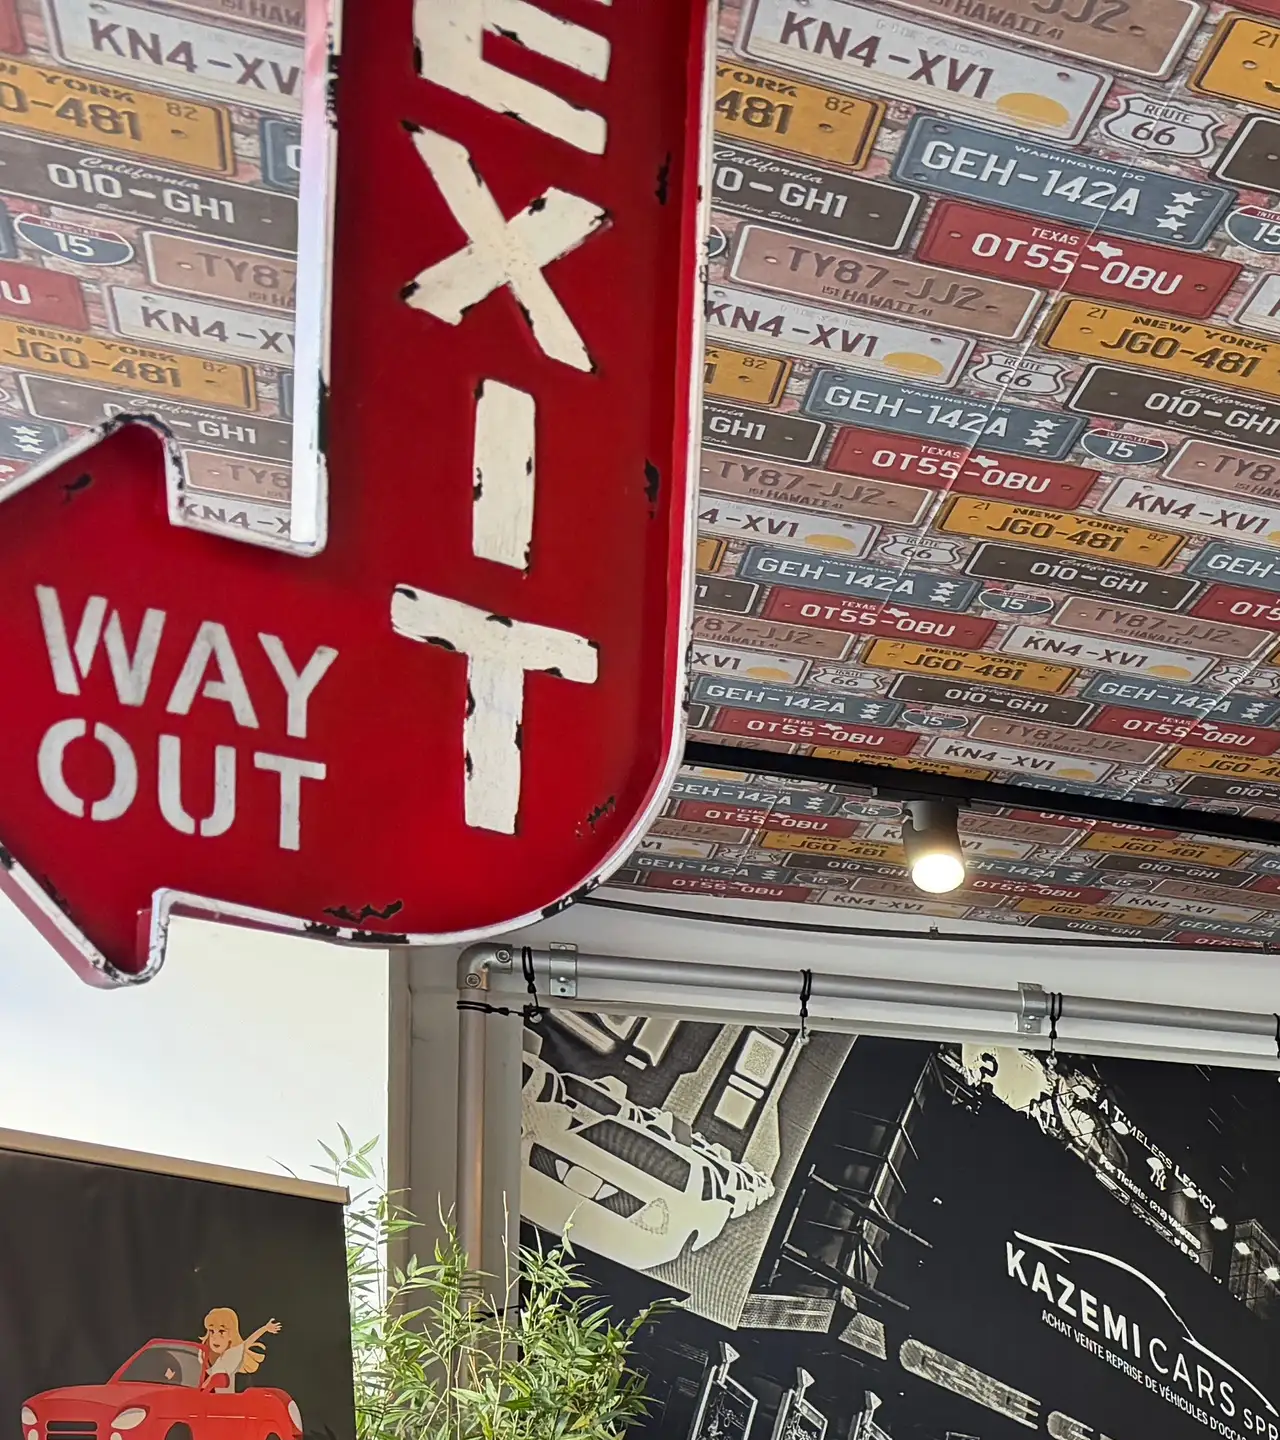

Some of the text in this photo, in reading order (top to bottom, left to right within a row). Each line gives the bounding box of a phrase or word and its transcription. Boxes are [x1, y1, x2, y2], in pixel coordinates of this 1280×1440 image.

[89, 17, 298, 96] KN4-XV
[1129, 124, 1181, 146] 66
[920, 140, 1139, 215] GEH-142A
[52, 228, 93, 258] 15
[1029, 226, 1081, 245] TEXAS
[824, 385, 1006, 437] GEH-142A
[1101, 440, 1140, 457] 15
[36, 585, 339, 739] WAY
[37, 718, 327, 852] OUT
[1111, 1105, 1174, 1170] TMELESS
[1006, 1241, 1141, 1359] KAZEMI
[1149, 1337, 1236, 1418] CARS
[1041, 1309, 1072, 1338] ACHAT
[1073, 1329, 1105, 1360] VENTE
[1105, 1350, 1144, 1384] REPRISE
[1144, 1374, 1158, 1394] DE
[1158, 1384, 1209, 1426] VÉHICULES
